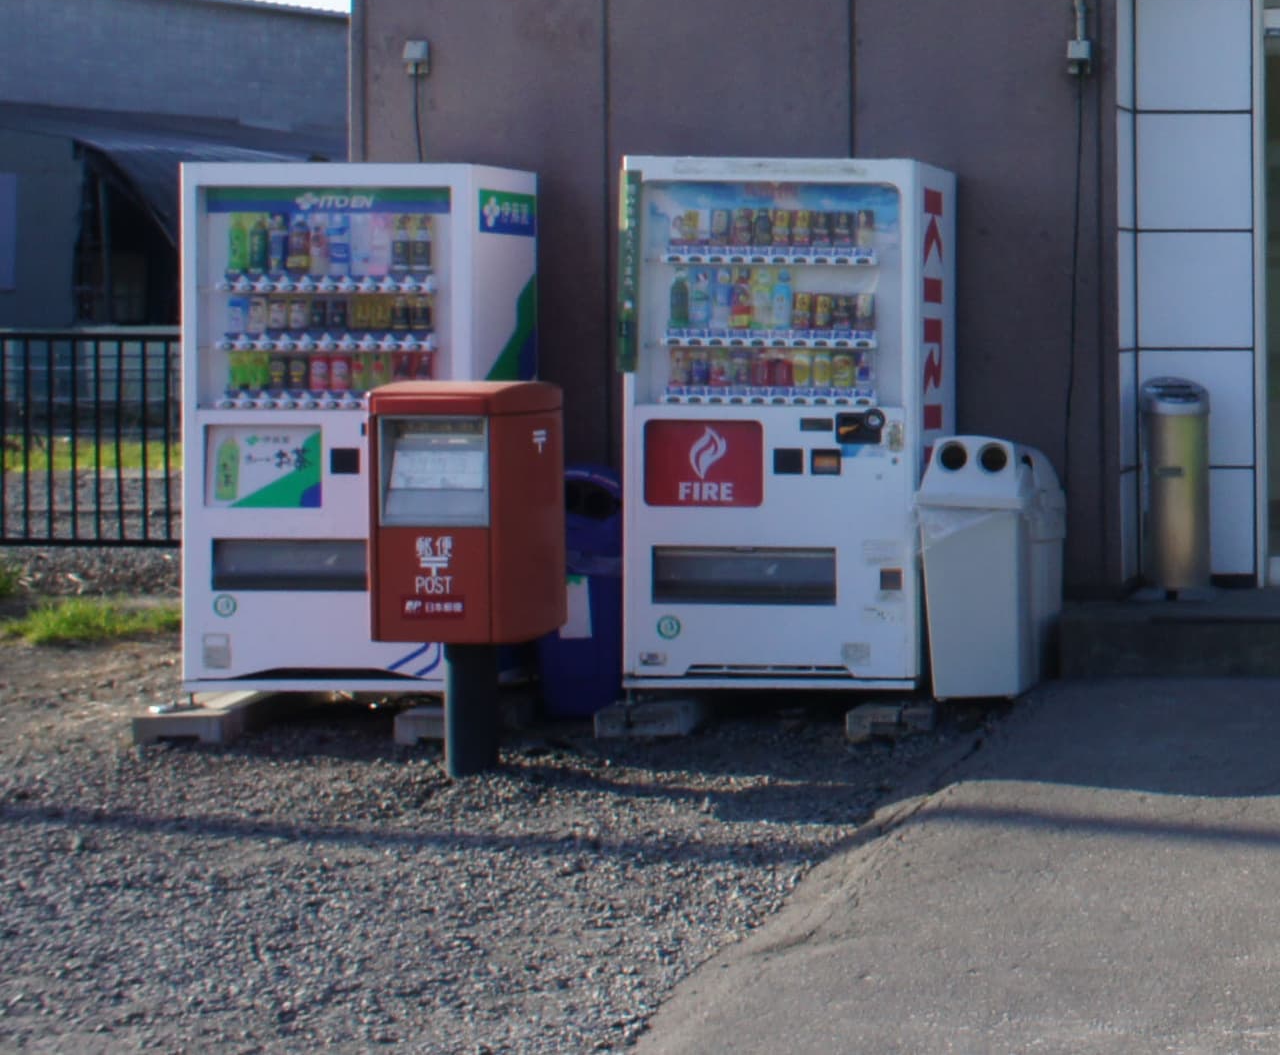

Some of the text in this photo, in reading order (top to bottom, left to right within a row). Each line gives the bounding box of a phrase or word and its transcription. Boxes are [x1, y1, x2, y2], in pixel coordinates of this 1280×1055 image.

[923, 187, 943, 466] KIRI
[678, 481, 734, 502] FIRE
[415, 536, 453, 557] 郵便
[415, 575, 453, 595] POST
